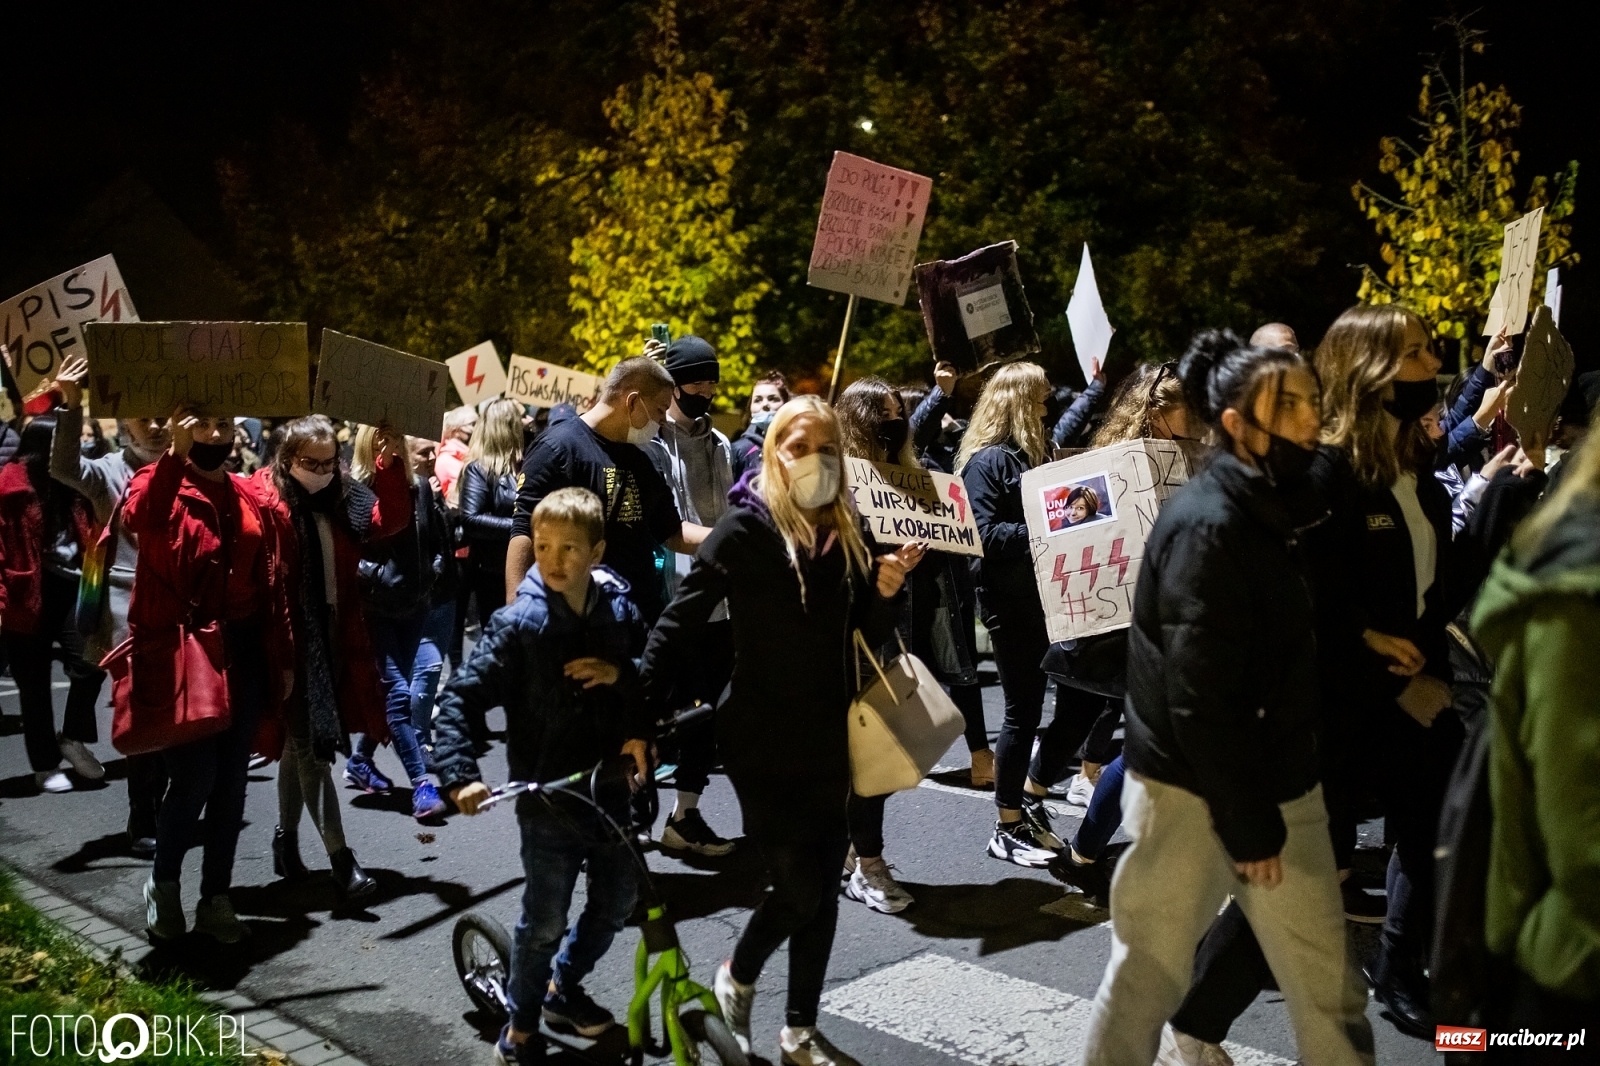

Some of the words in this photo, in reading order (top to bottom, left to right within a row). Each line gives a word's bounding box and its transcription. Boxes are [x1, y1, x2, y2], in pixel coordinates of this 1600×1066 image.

[837, 167, 859, 186] DO
[18, 273, 95, 332] PIS
[94, 325, 174, 365] MOJE
[187, 327, 281, 363] CIAŁO
[202, 364, 300, 407] WYBÓR
[852, 462, 933, 491] WALCZCIE
[876, 515, 891, 535] Z
[893, 517, 975, 547] KOBIETAMI
